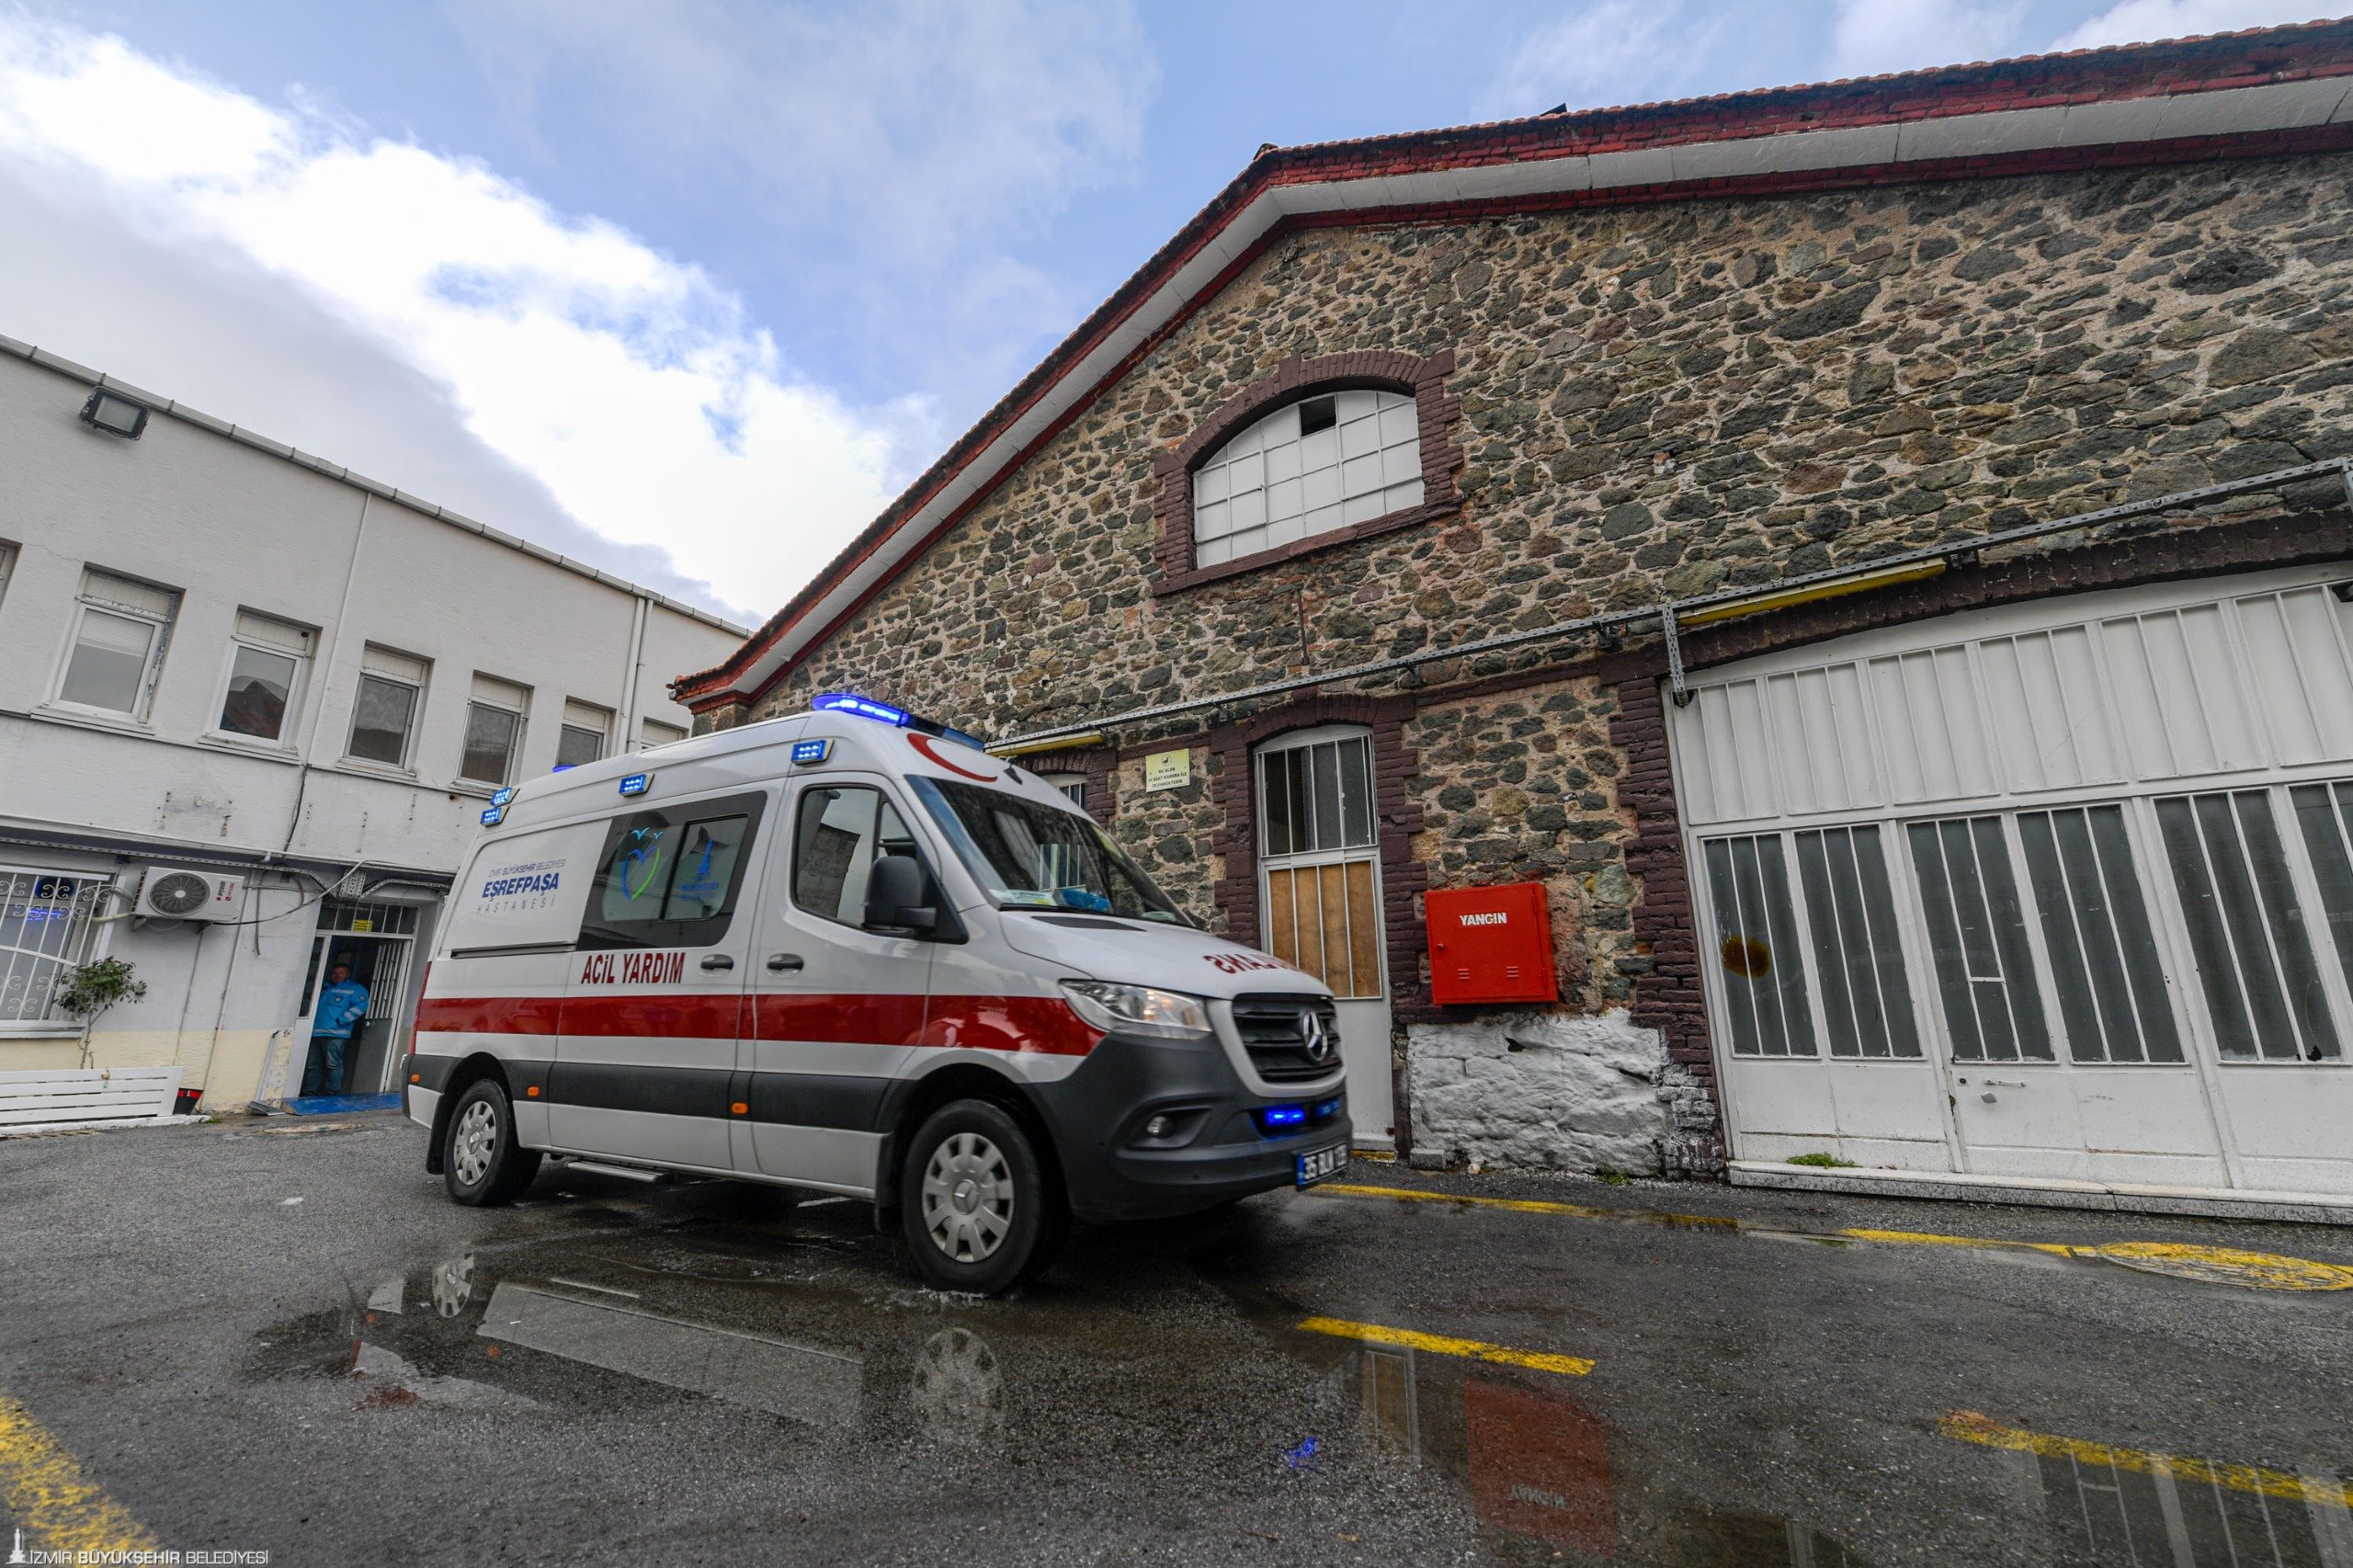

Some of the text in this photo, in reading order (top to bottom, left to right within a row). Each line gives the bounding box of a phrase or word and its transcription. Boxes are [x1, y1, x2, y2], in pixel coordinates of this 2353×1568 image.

[482, 872, 560, 902] EŞREFPAŞA
[1459, 912, 1507, 926] YANGIN
[622, 952, 686, 983] YARDIM
